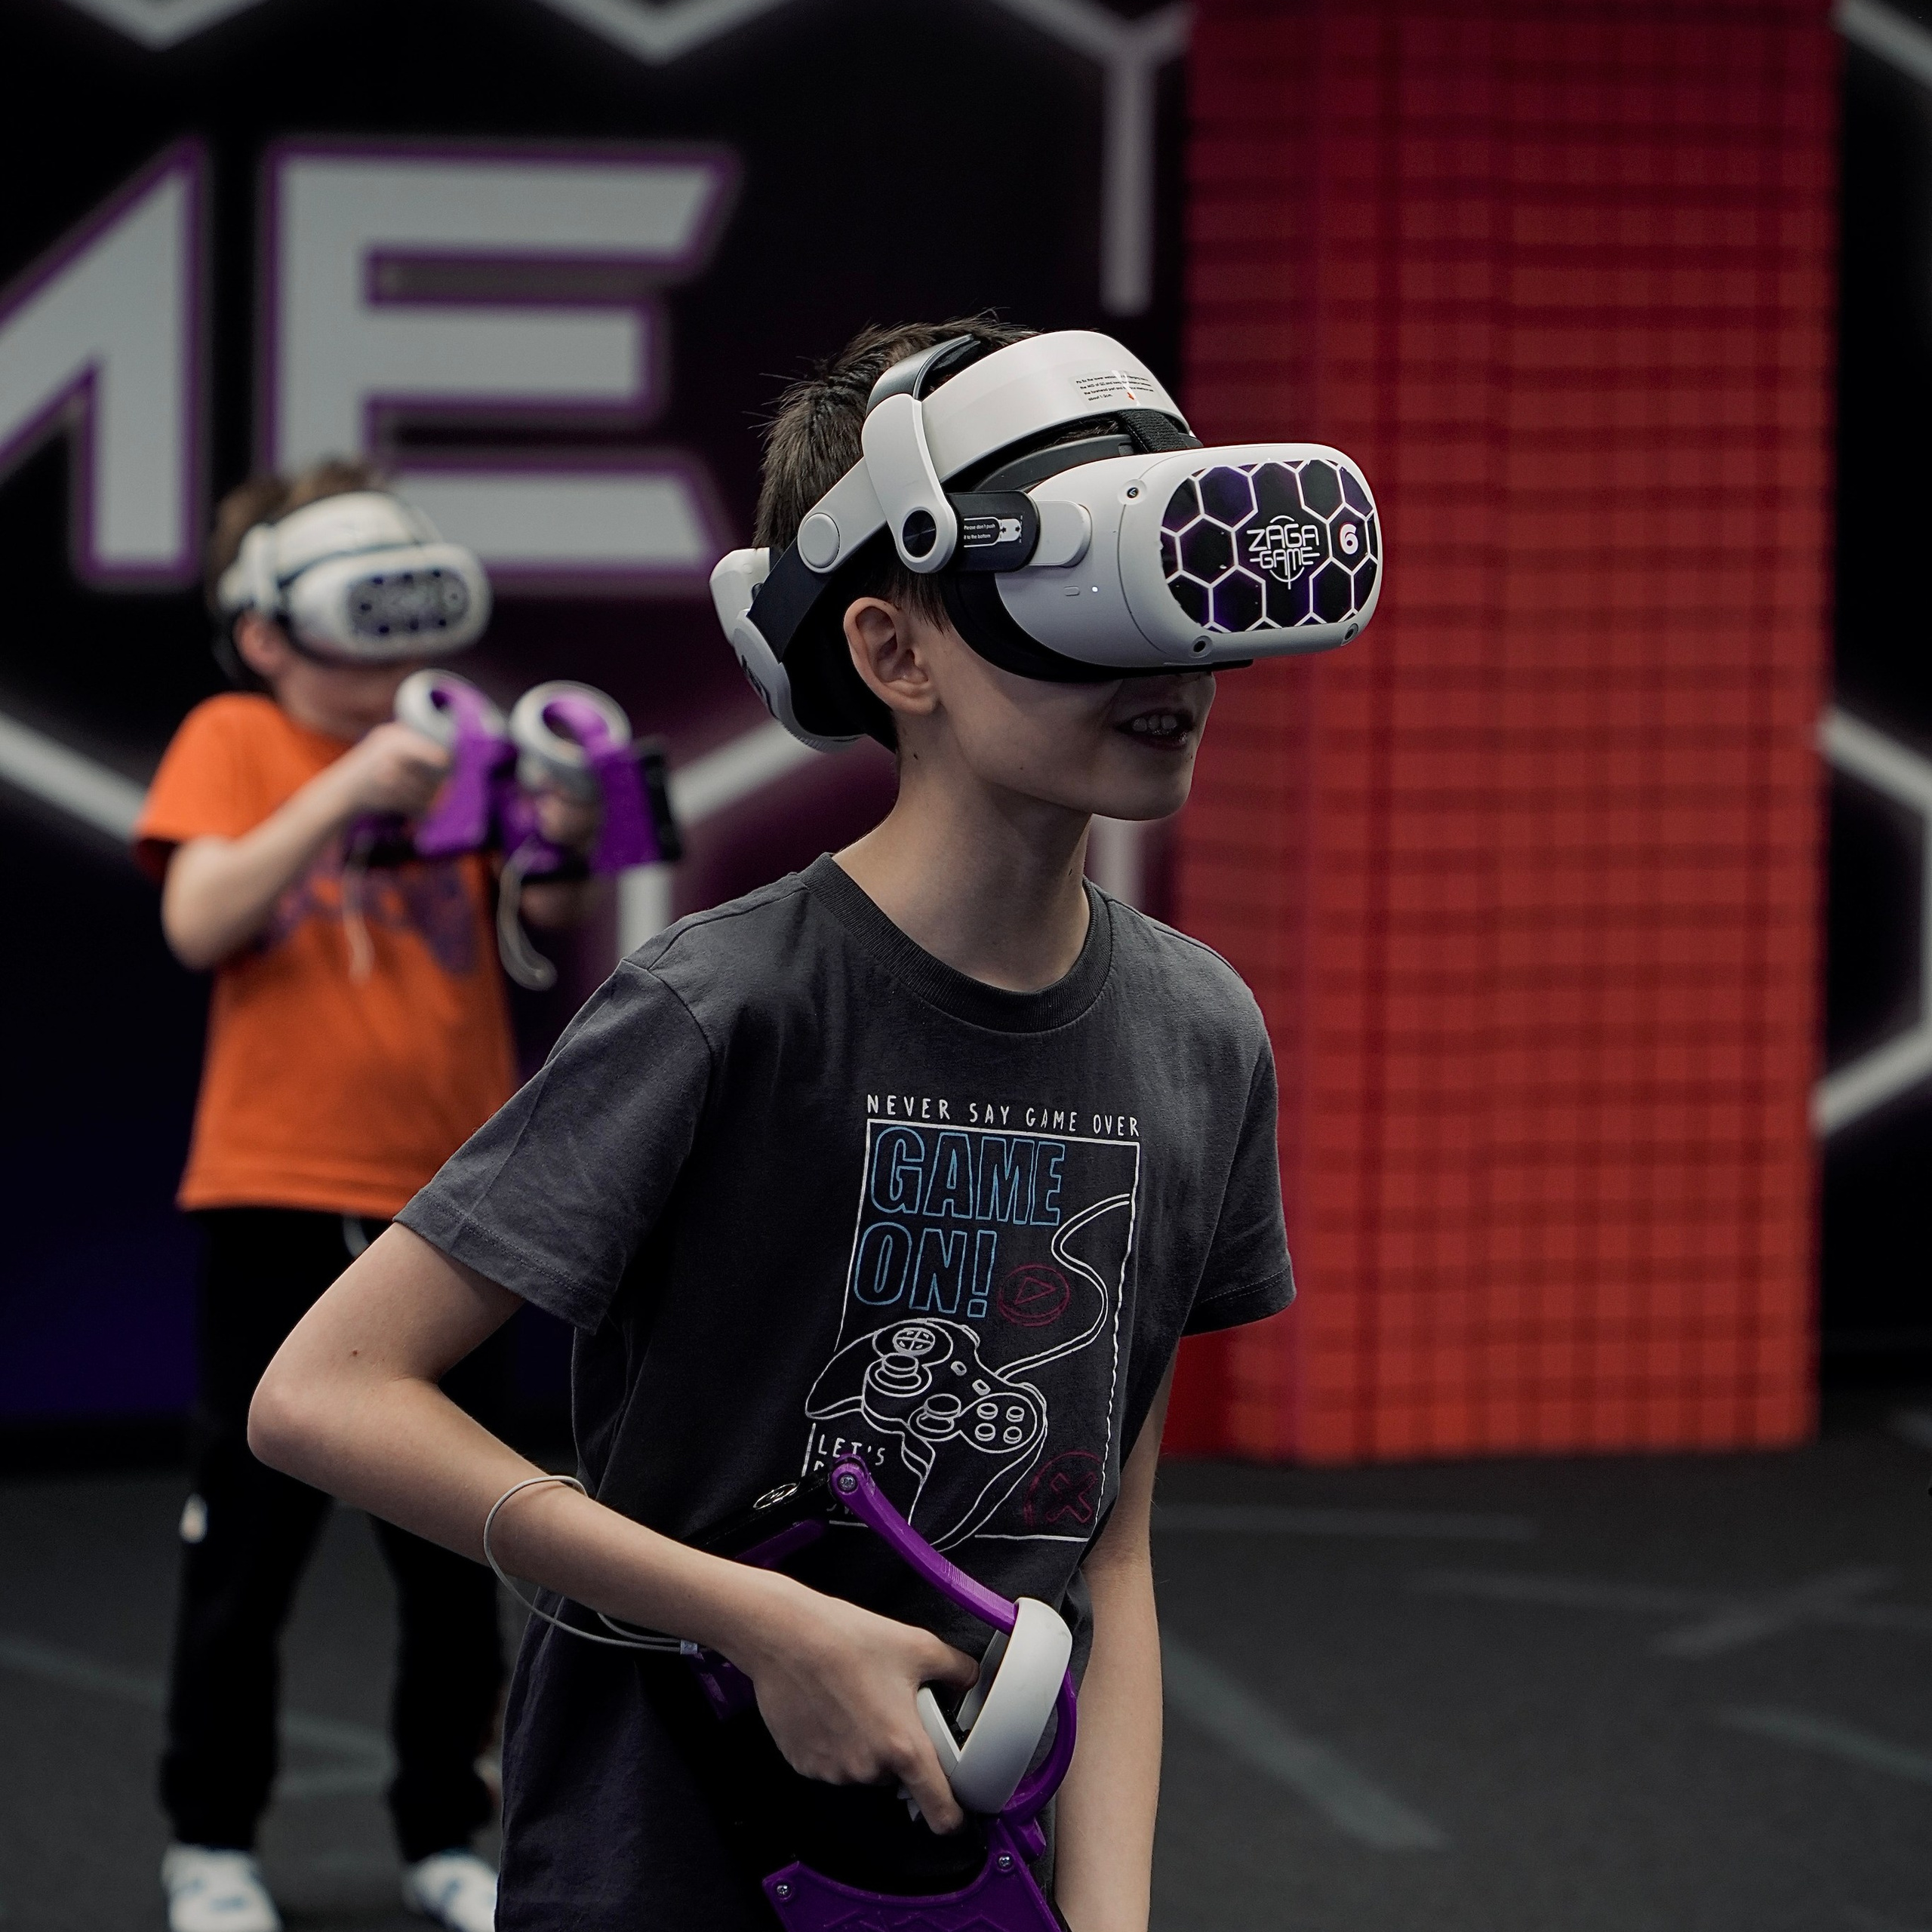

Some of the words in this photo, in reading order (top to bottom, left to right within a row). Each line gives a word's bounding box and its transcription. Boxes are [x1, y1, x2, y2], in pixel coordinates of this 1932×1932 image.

[1246, 524, 1320, 552] ZAGA
[1340, 523, 1359, 555] 6
[1251, 546, 1319, 577] GAME
[867, 1094, 950, 1120] NEVER
[969, 1103, 1011, 1126] SAY
[1026, 1107, 1078, 1132] GAME
[1093, 1114, 1140, 1137] OVER
[871, 1126, 1066, 1226] GAME
[854, 1221, 998, 1318] ON!
[817, 1434, 885, 1466] LET'S
